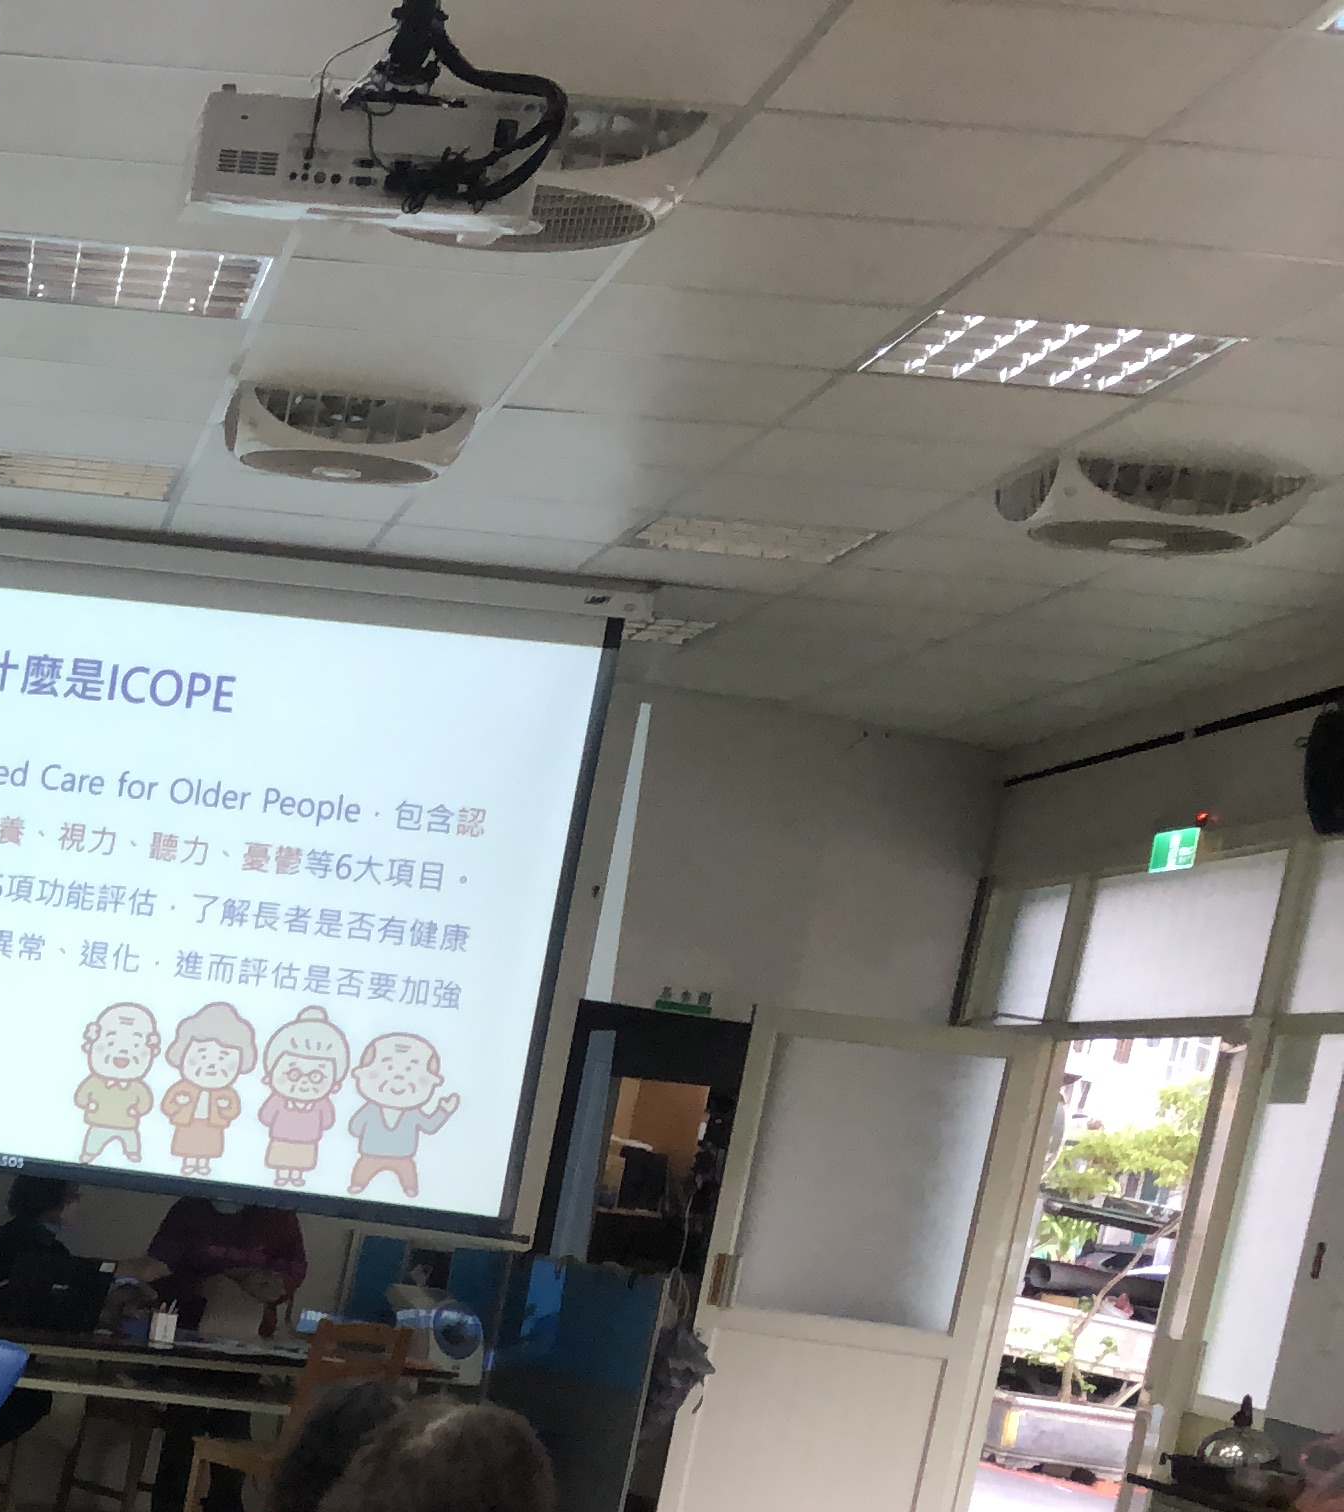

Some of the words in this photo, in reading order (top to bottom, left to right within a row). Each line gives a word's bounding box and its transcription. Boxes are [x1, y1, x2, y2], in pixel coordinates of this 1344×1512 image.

[40, 763, 105, 795] Care
[118, 770, 158, 801] for
[169, 777, 251, 811] Older
